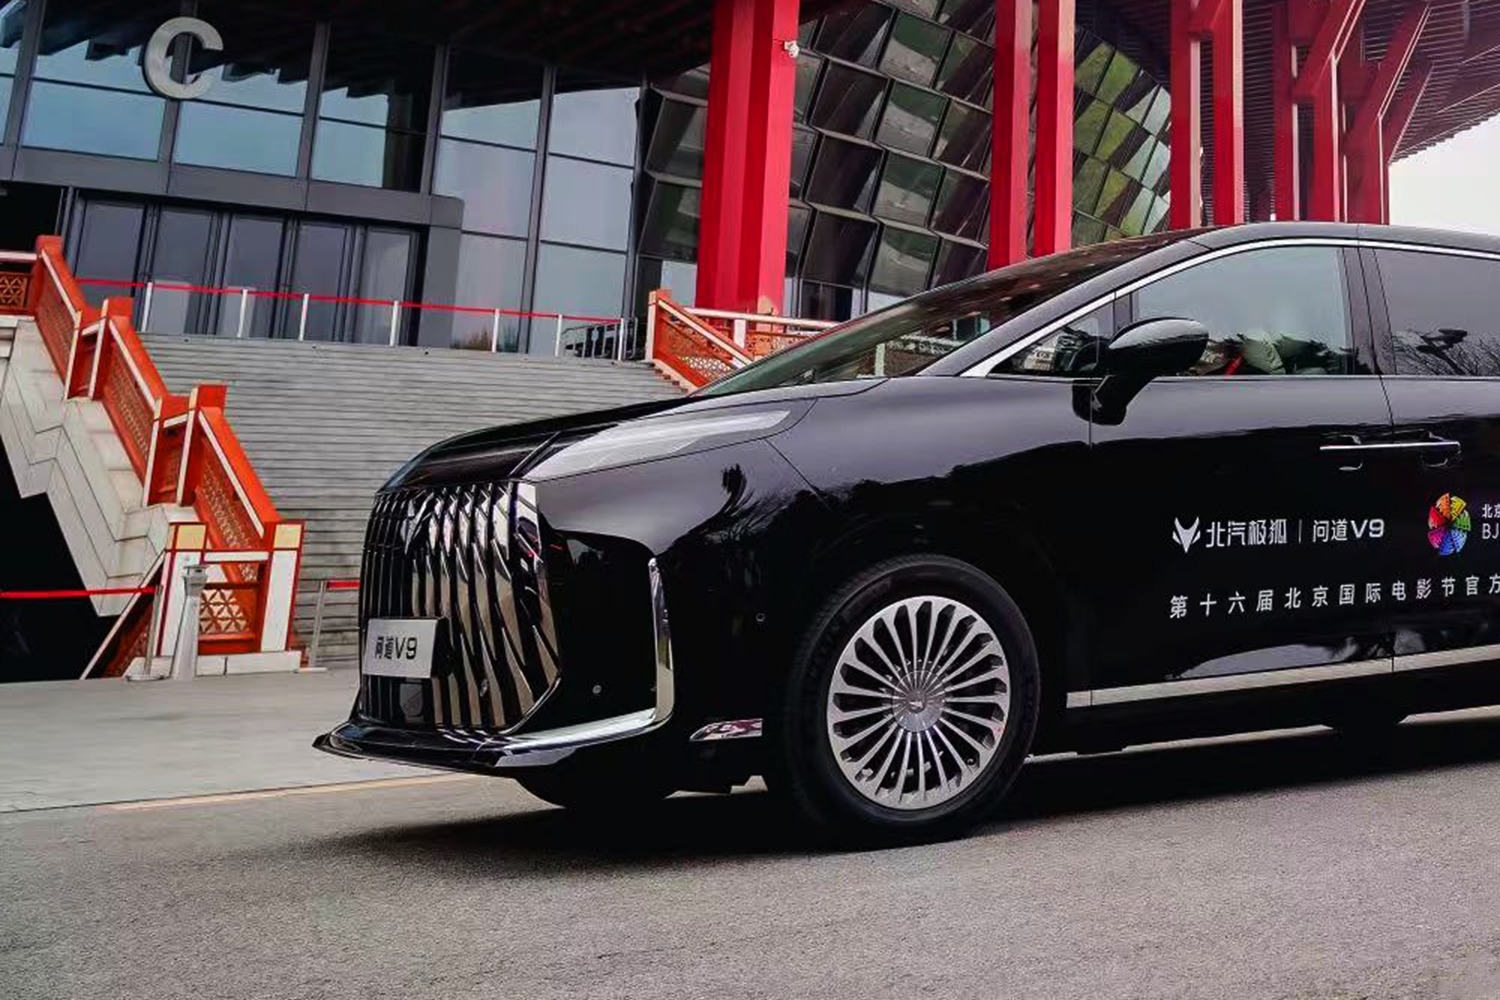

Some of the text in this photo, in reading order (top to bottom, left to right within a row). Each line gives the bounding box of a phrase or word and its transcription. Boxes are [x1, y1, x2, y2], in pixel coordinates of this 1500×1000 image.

[144, 16, 224, 100] C
[1205, 518, 1288, 548] 北汽极狐
